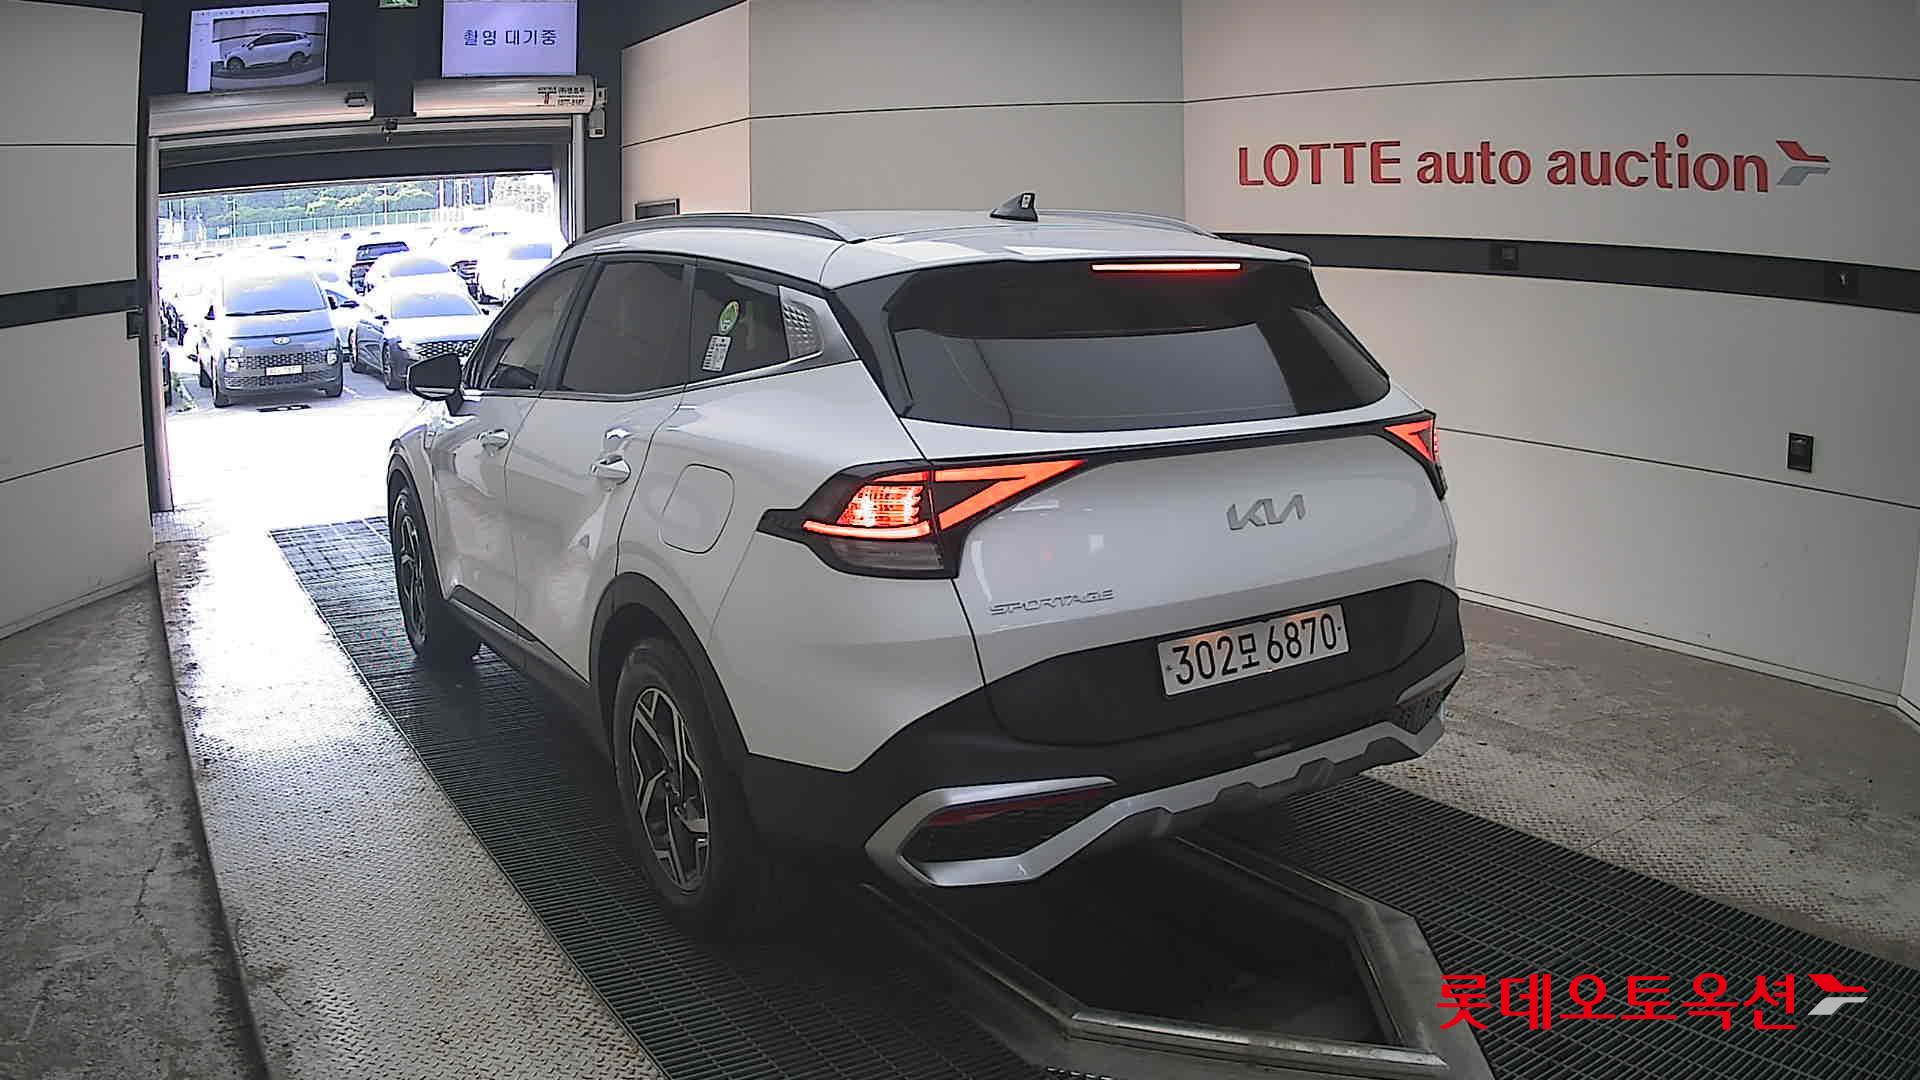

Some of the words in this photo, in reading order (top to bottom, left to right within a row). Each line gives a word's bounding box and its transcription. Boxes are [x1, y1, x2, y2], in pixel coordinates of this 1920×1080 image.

[504, 29, 558, 46] 대기중
[1238, 141, 1401, 187] LOTTE
[1416, 140, 1532, 185] auto
[1547, 133, 1769, 193] auction
[1225, 493, 1307, 531] KIA
[990, 589, 1115, 616] SPORTAGE
[1266, 613, 1338, 664] 6870
